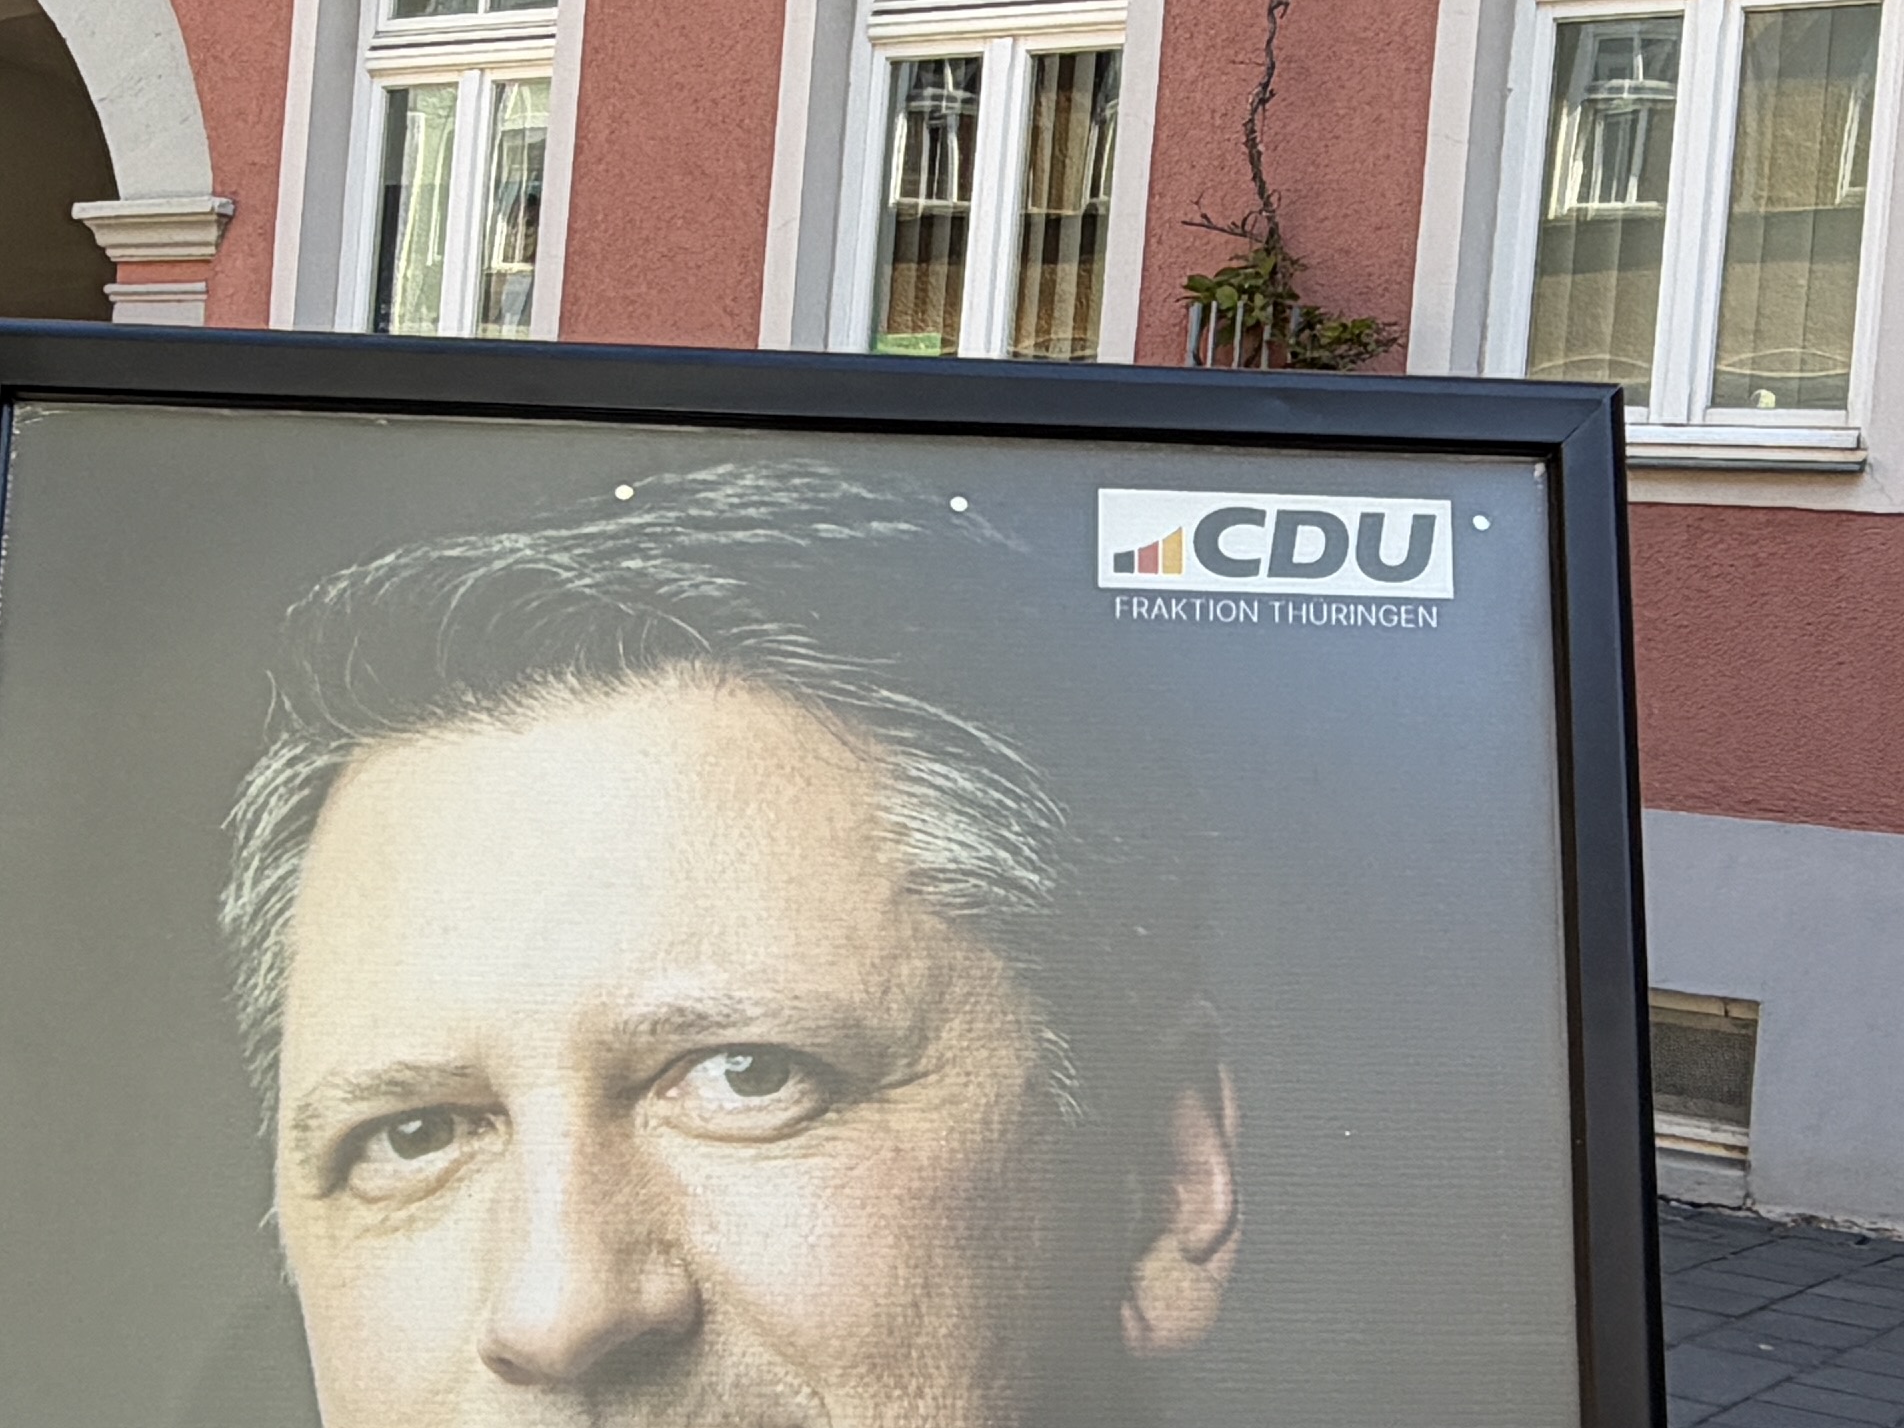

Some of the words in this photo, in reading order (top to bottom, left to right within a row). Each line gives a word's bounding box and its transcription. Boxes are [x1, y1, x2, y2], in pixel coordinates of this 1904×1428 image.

[1192, 506, 1437, 583] CDU
[1114, 596, 1259, 624] FRAKTION
[1272, 597, 1439, 629] THÜRINGEN
